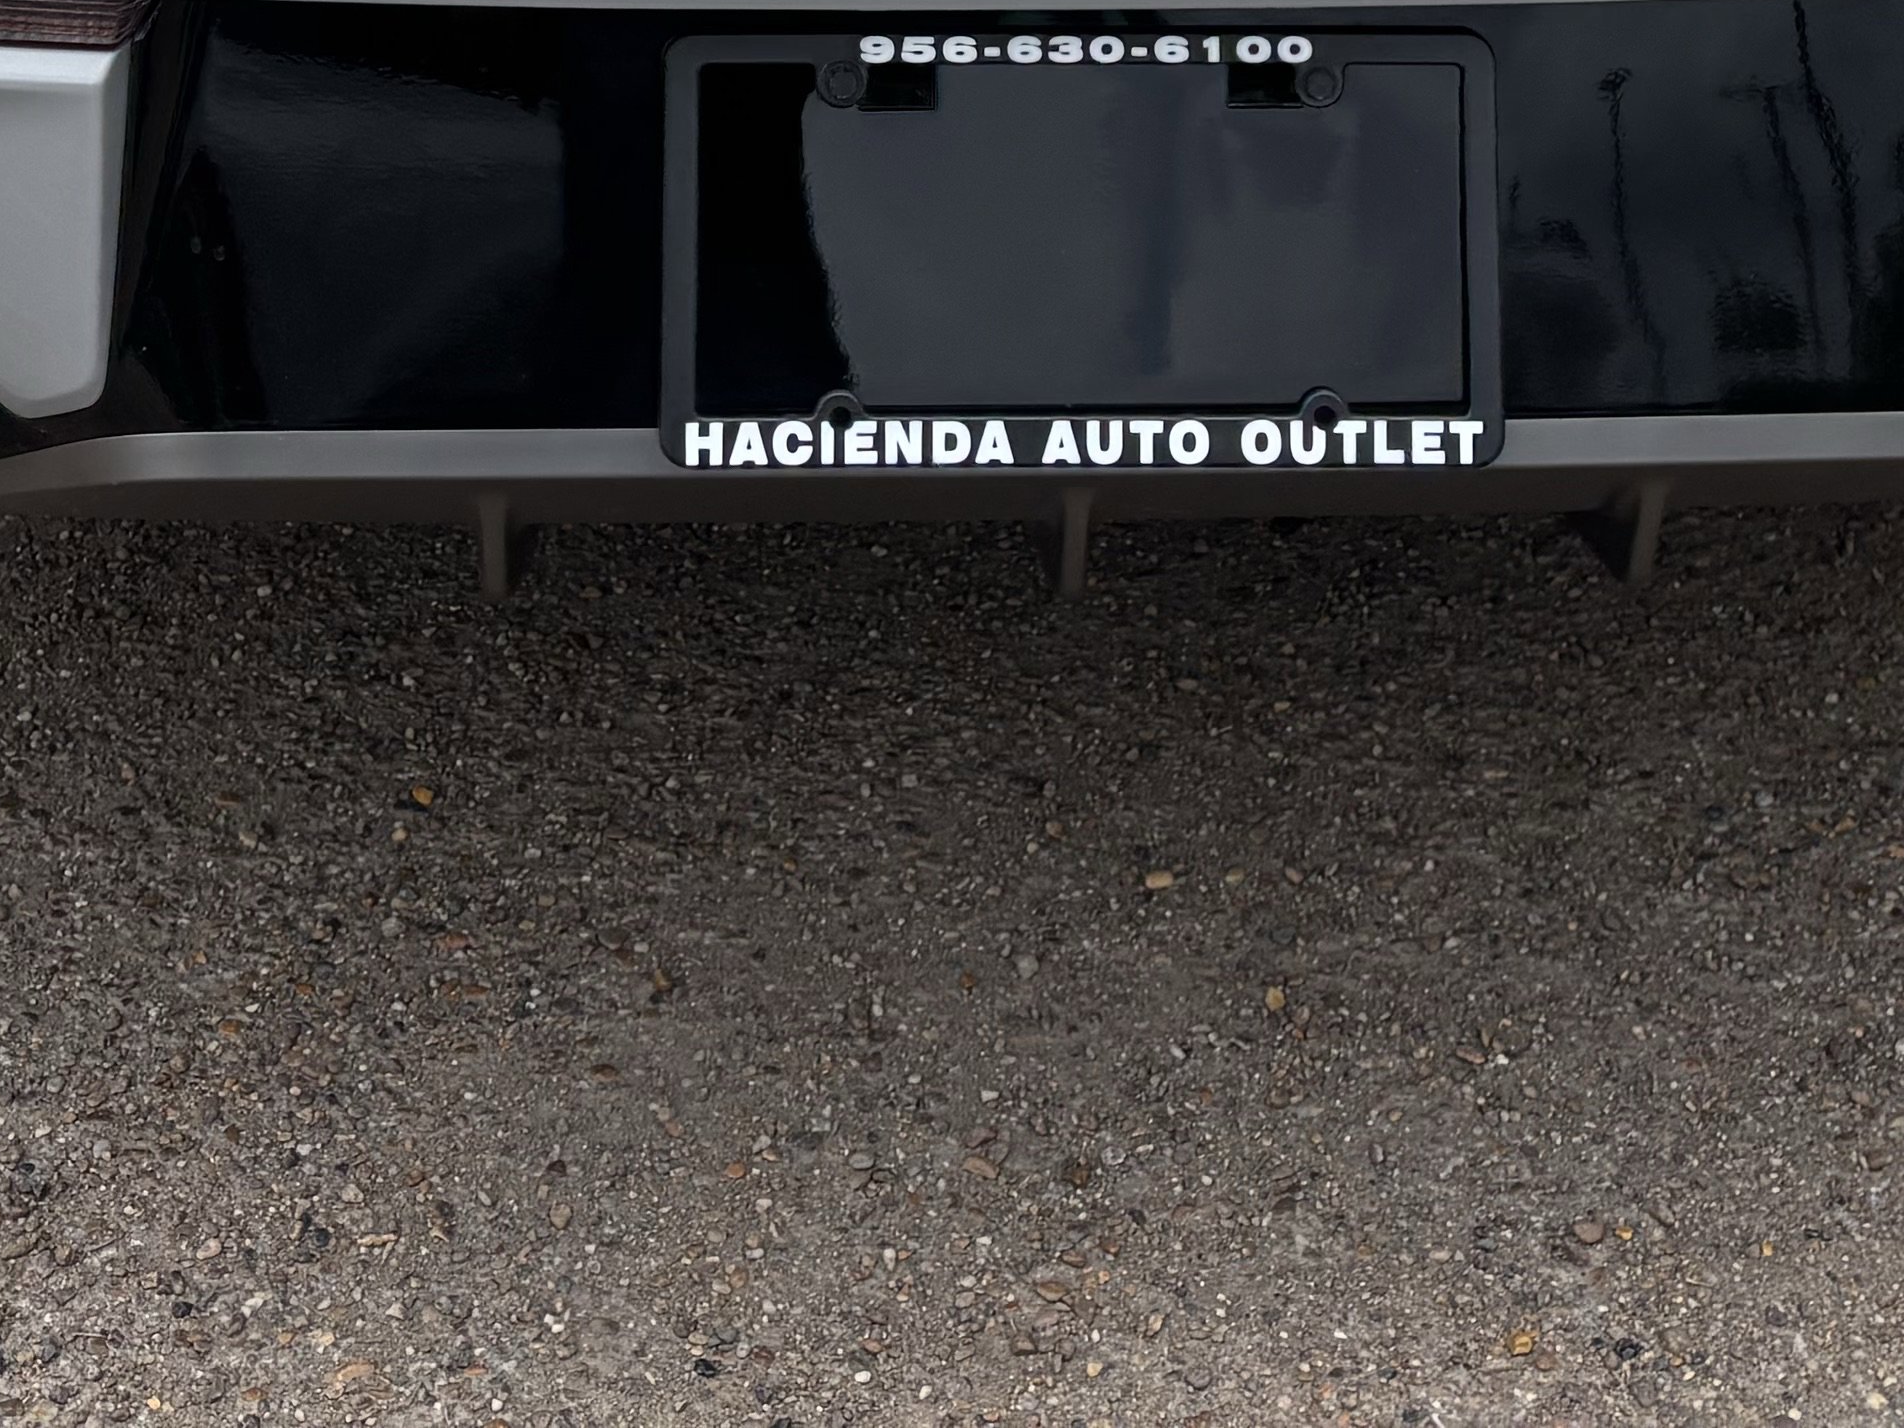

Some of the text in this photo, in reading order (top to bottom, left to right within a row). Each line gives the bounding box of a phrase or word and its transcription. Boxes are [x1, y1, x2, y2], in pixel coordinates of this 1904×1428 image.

[859, 35, 1313, 64] 956-630-6100
[684, 419, 1485, 467] HACIENDA AUTO OUTLET
